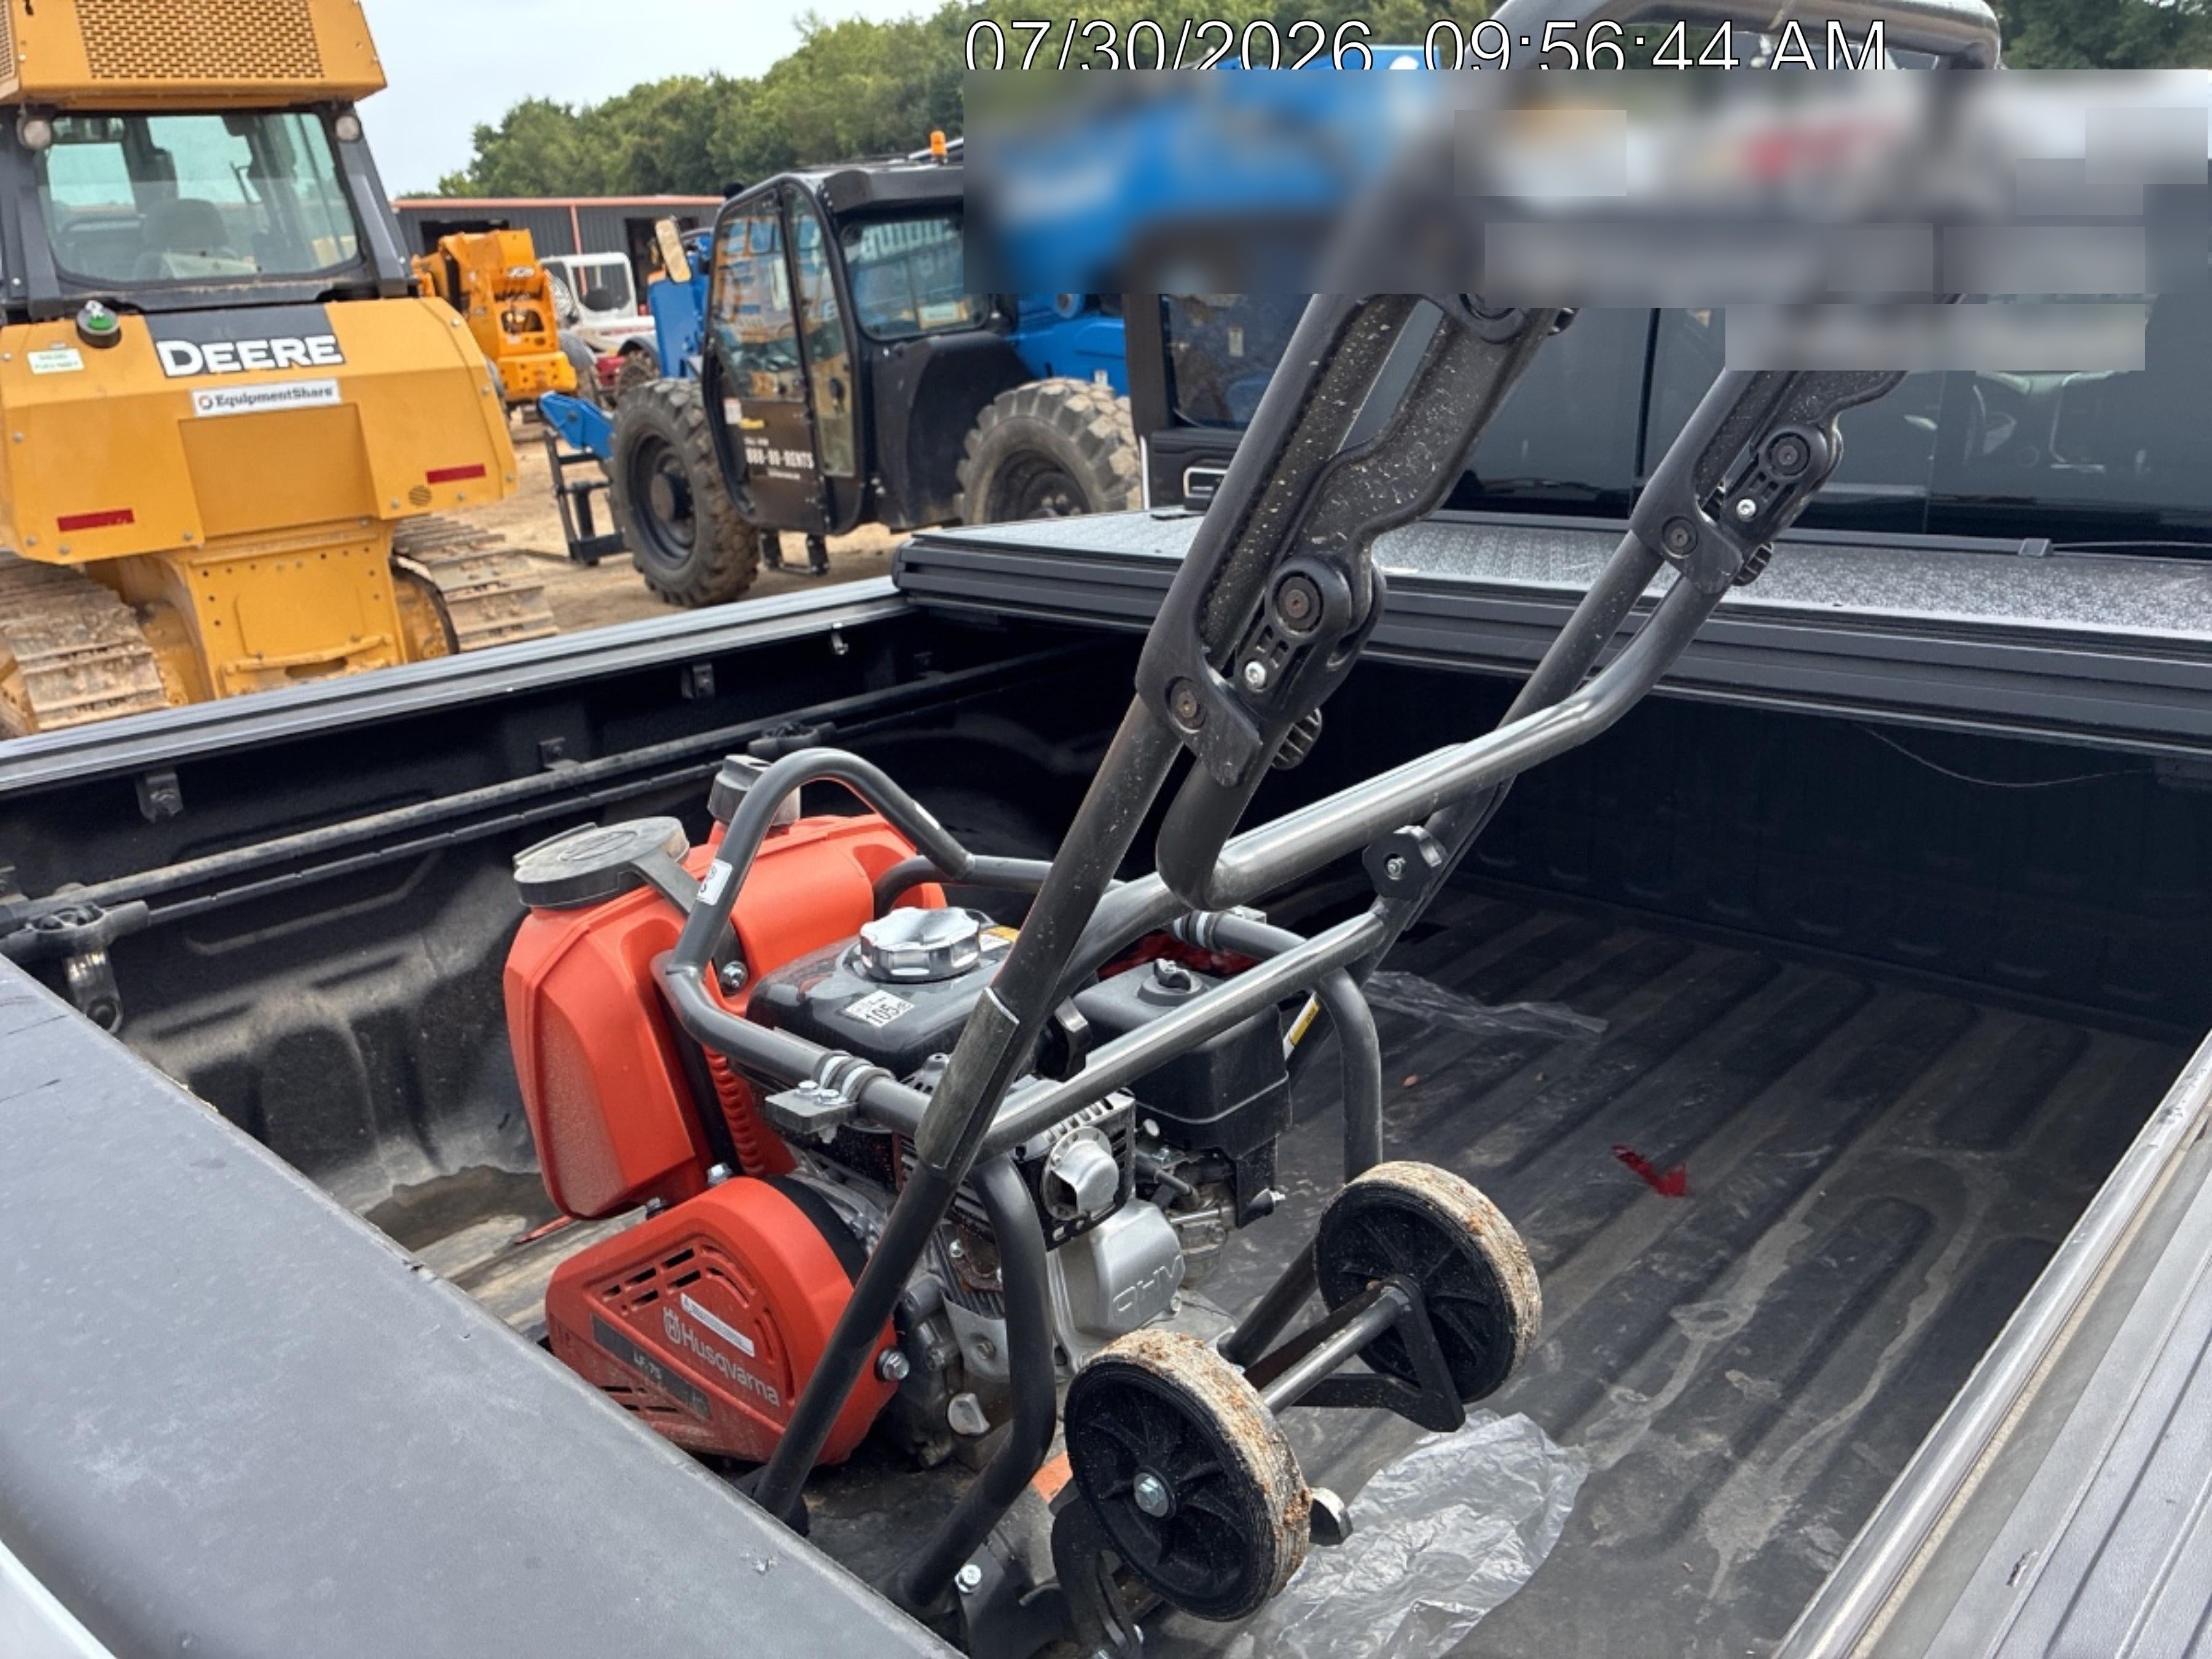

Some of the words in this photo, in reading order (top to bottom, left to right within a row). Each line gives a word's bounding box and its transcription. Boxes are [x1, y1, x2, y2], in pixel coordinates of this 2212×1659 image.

[156, 335, 343, 377] DEERE
[215, 386, 332, 408] EquipmentShare
[681, 1322, 780, 1408] Husqvarna
